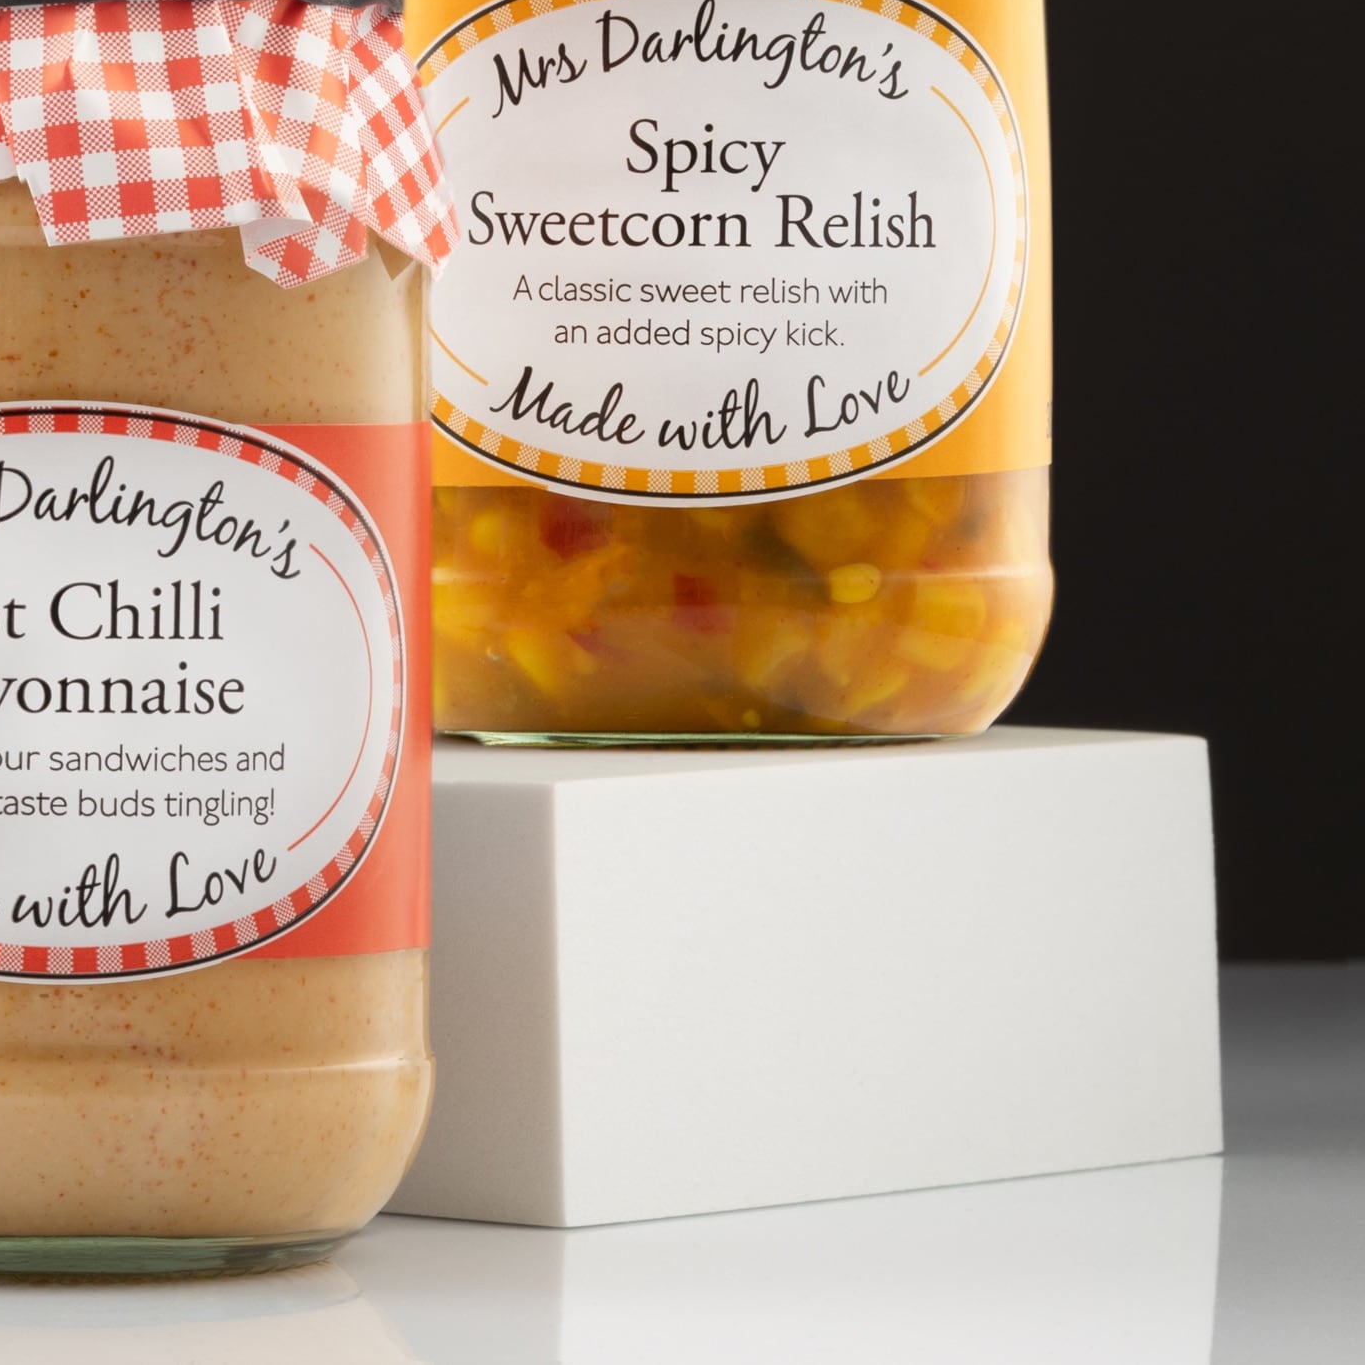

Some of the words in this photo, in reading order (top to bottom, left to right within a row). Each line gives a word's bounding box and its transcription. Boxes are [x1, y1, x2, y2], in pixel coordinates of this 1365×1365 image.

[492, 42, 588, 119] Mrs
[626, 118, 787, 193] Spicy
[468, 190, 752, 248] Sweetcorn
[774, 190, 937, 249] Relish
[512, 274, 533, 301] A
[538, 274, 632, 303] classic
[640, 280, 732, 304] sweet
[740, 277, 820, 304] relish
[828, 277, 888, 304] with
[554, 324, 588, 344] an
[596, 318, 690, 346] added
[700, 326, 778, 355] spicy
[786, 319, 845, 347] kick.
[489, 365, 646, 445] Made
[657, 377, 788, 451] with
[803, 370, 910, 439] Love
[49, 579, 224, 641] Chilli
[49, 743, 228, 773] sandwiches
[236, 742, 285, 772] and
[78, 788, 156, 818] buds
[163, 787, 275, 827] tingling!
[11, 852, 148, 929] with
[164, 848, 282, 919] Love
